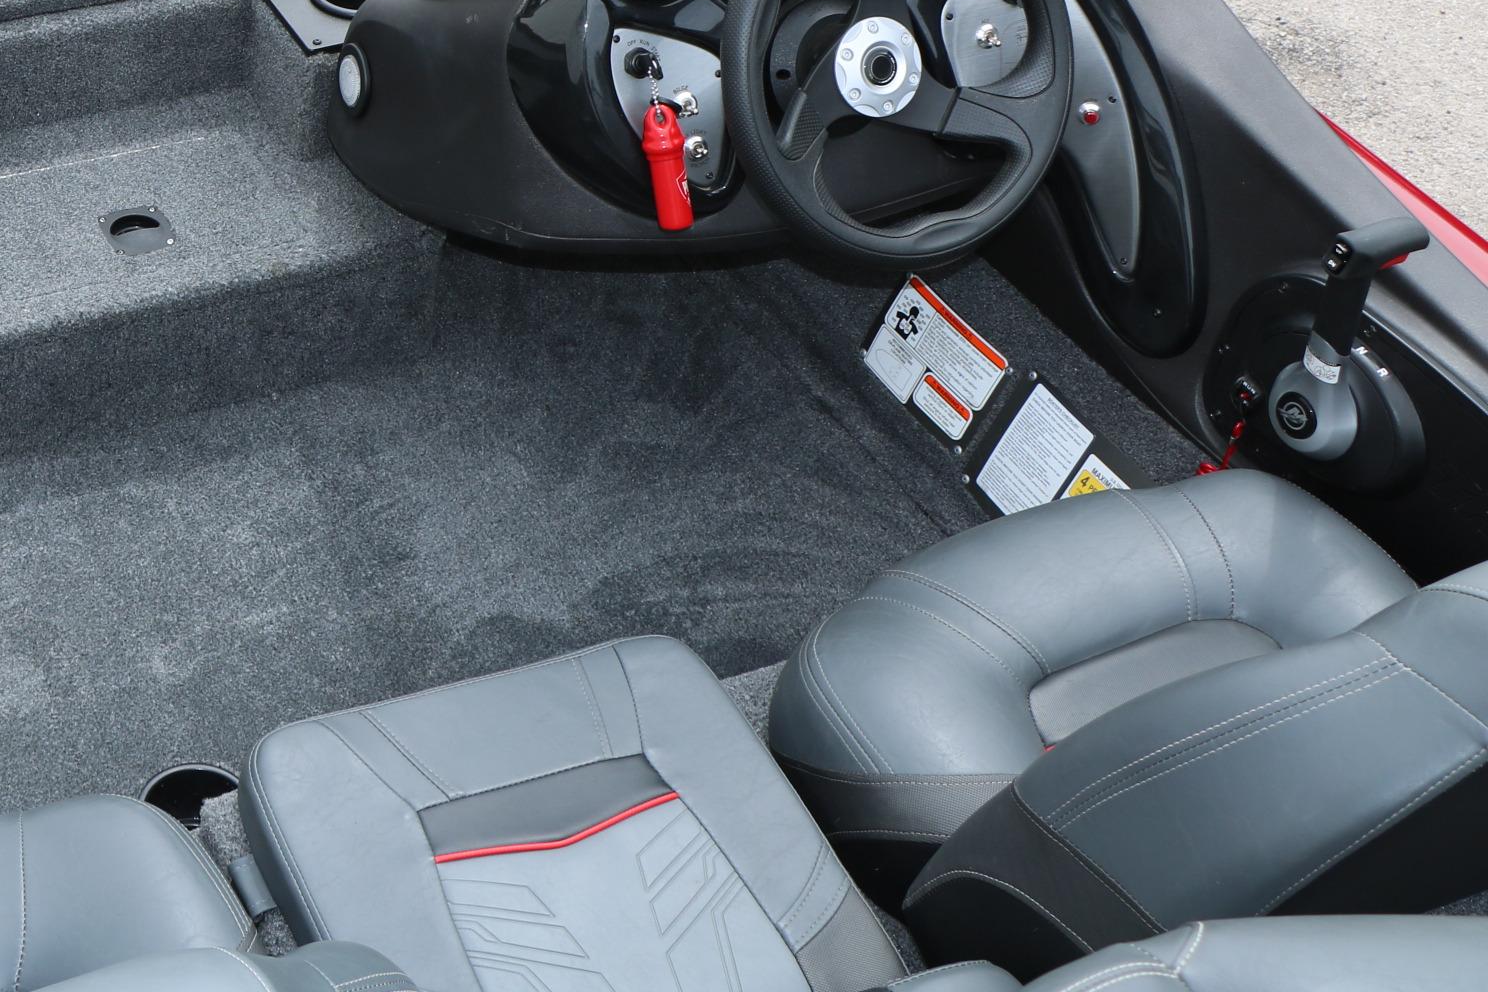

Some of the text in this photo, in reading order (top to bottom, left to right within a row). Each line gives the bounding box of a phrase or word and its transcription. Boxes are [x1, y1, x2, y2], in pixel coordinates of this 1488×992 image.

[627, 39, 637, 47] OFF
[1356, 346, 1368, 355] N
[1377, 367, 1389, 378] R
[1242, 381, 1256, 395] RUN
[1080, 476, 1090, 486] 4
[1092, 468, 1112, 489] MAXIMU
